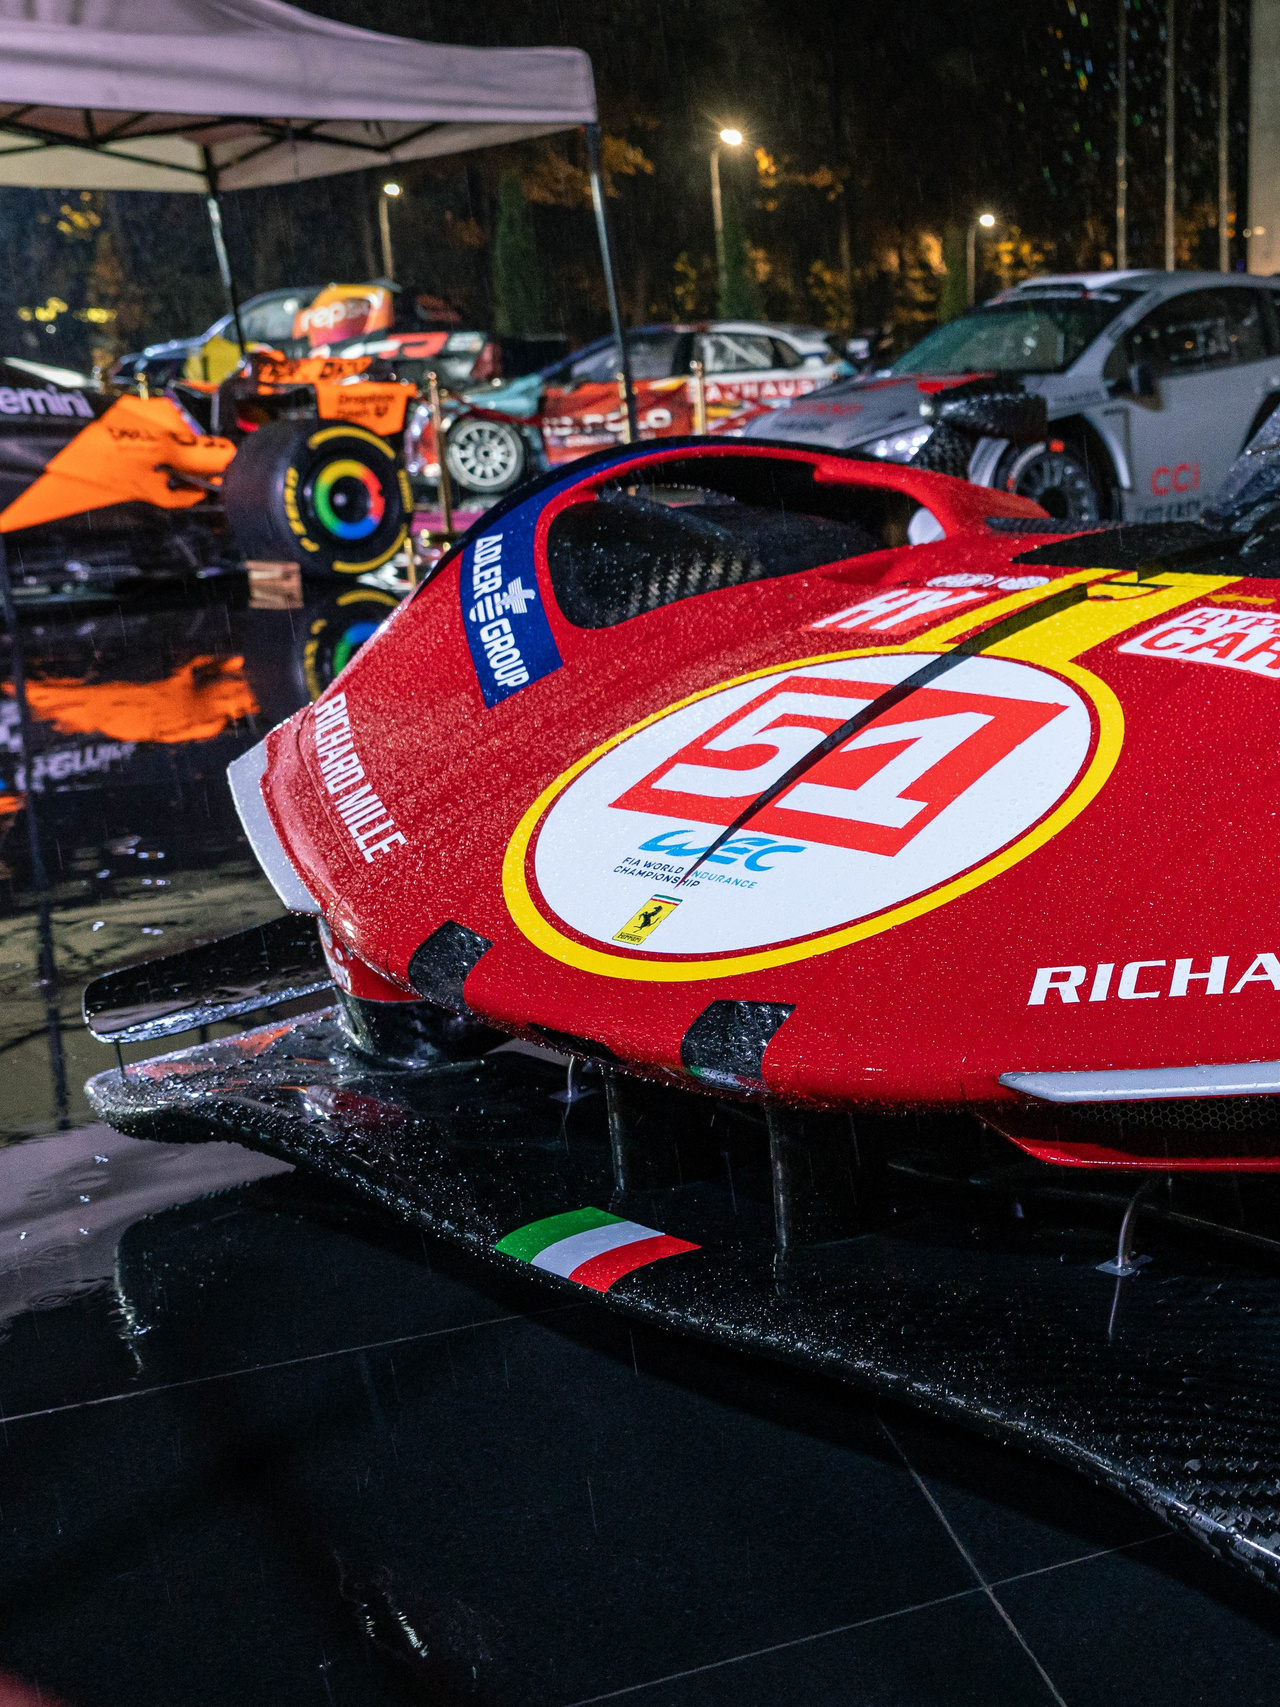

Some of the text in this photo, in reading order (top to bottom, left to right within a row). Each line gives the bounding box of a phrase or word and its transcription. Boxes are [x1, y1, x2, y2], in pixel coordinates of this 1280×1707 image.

[473, 533, 530, 687] ADLER GROUP
[314, 692, 407, 864] RICHARD MILLE
[651, 691, 996, 829] 51
[622, 856, 641, 867] FIA
[643, 861, 685, 874] WORLD
[637, 829, 808, 872] WEC
[613, 865, 701, 888] CHAMPIONSHIP
[618, 932, 643, 943] Ferrari
